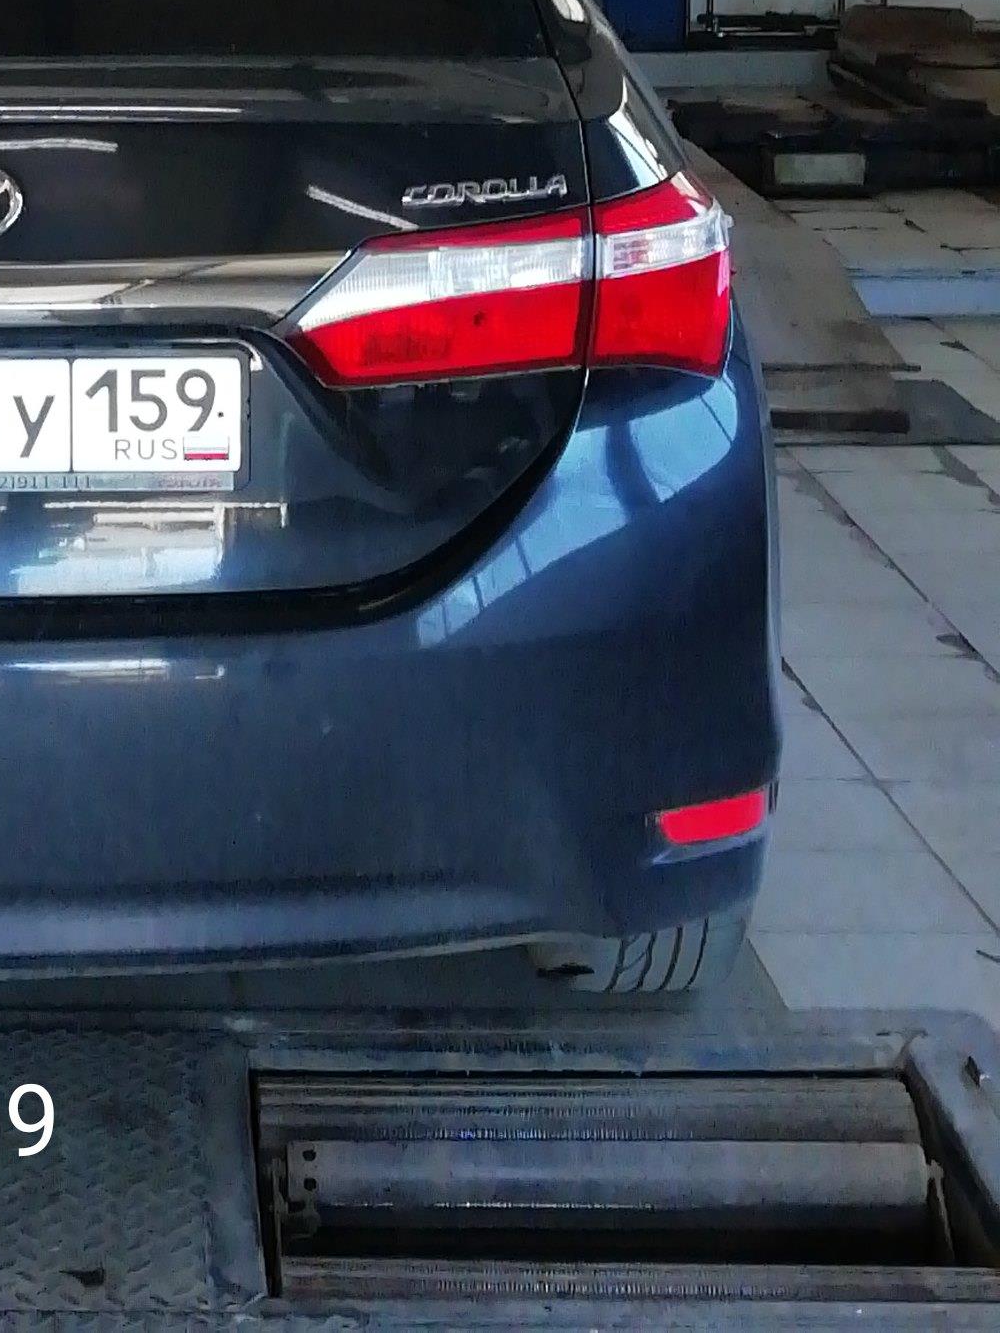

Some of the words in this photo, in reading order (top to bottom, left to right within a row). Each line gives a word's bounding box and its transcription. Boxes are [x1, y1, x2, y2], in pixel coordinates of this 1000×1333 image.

[401, 174, 568, 207] COROLLA
[85, 368, 216, 433] 159
[114, 439, 178, 461] RUS
